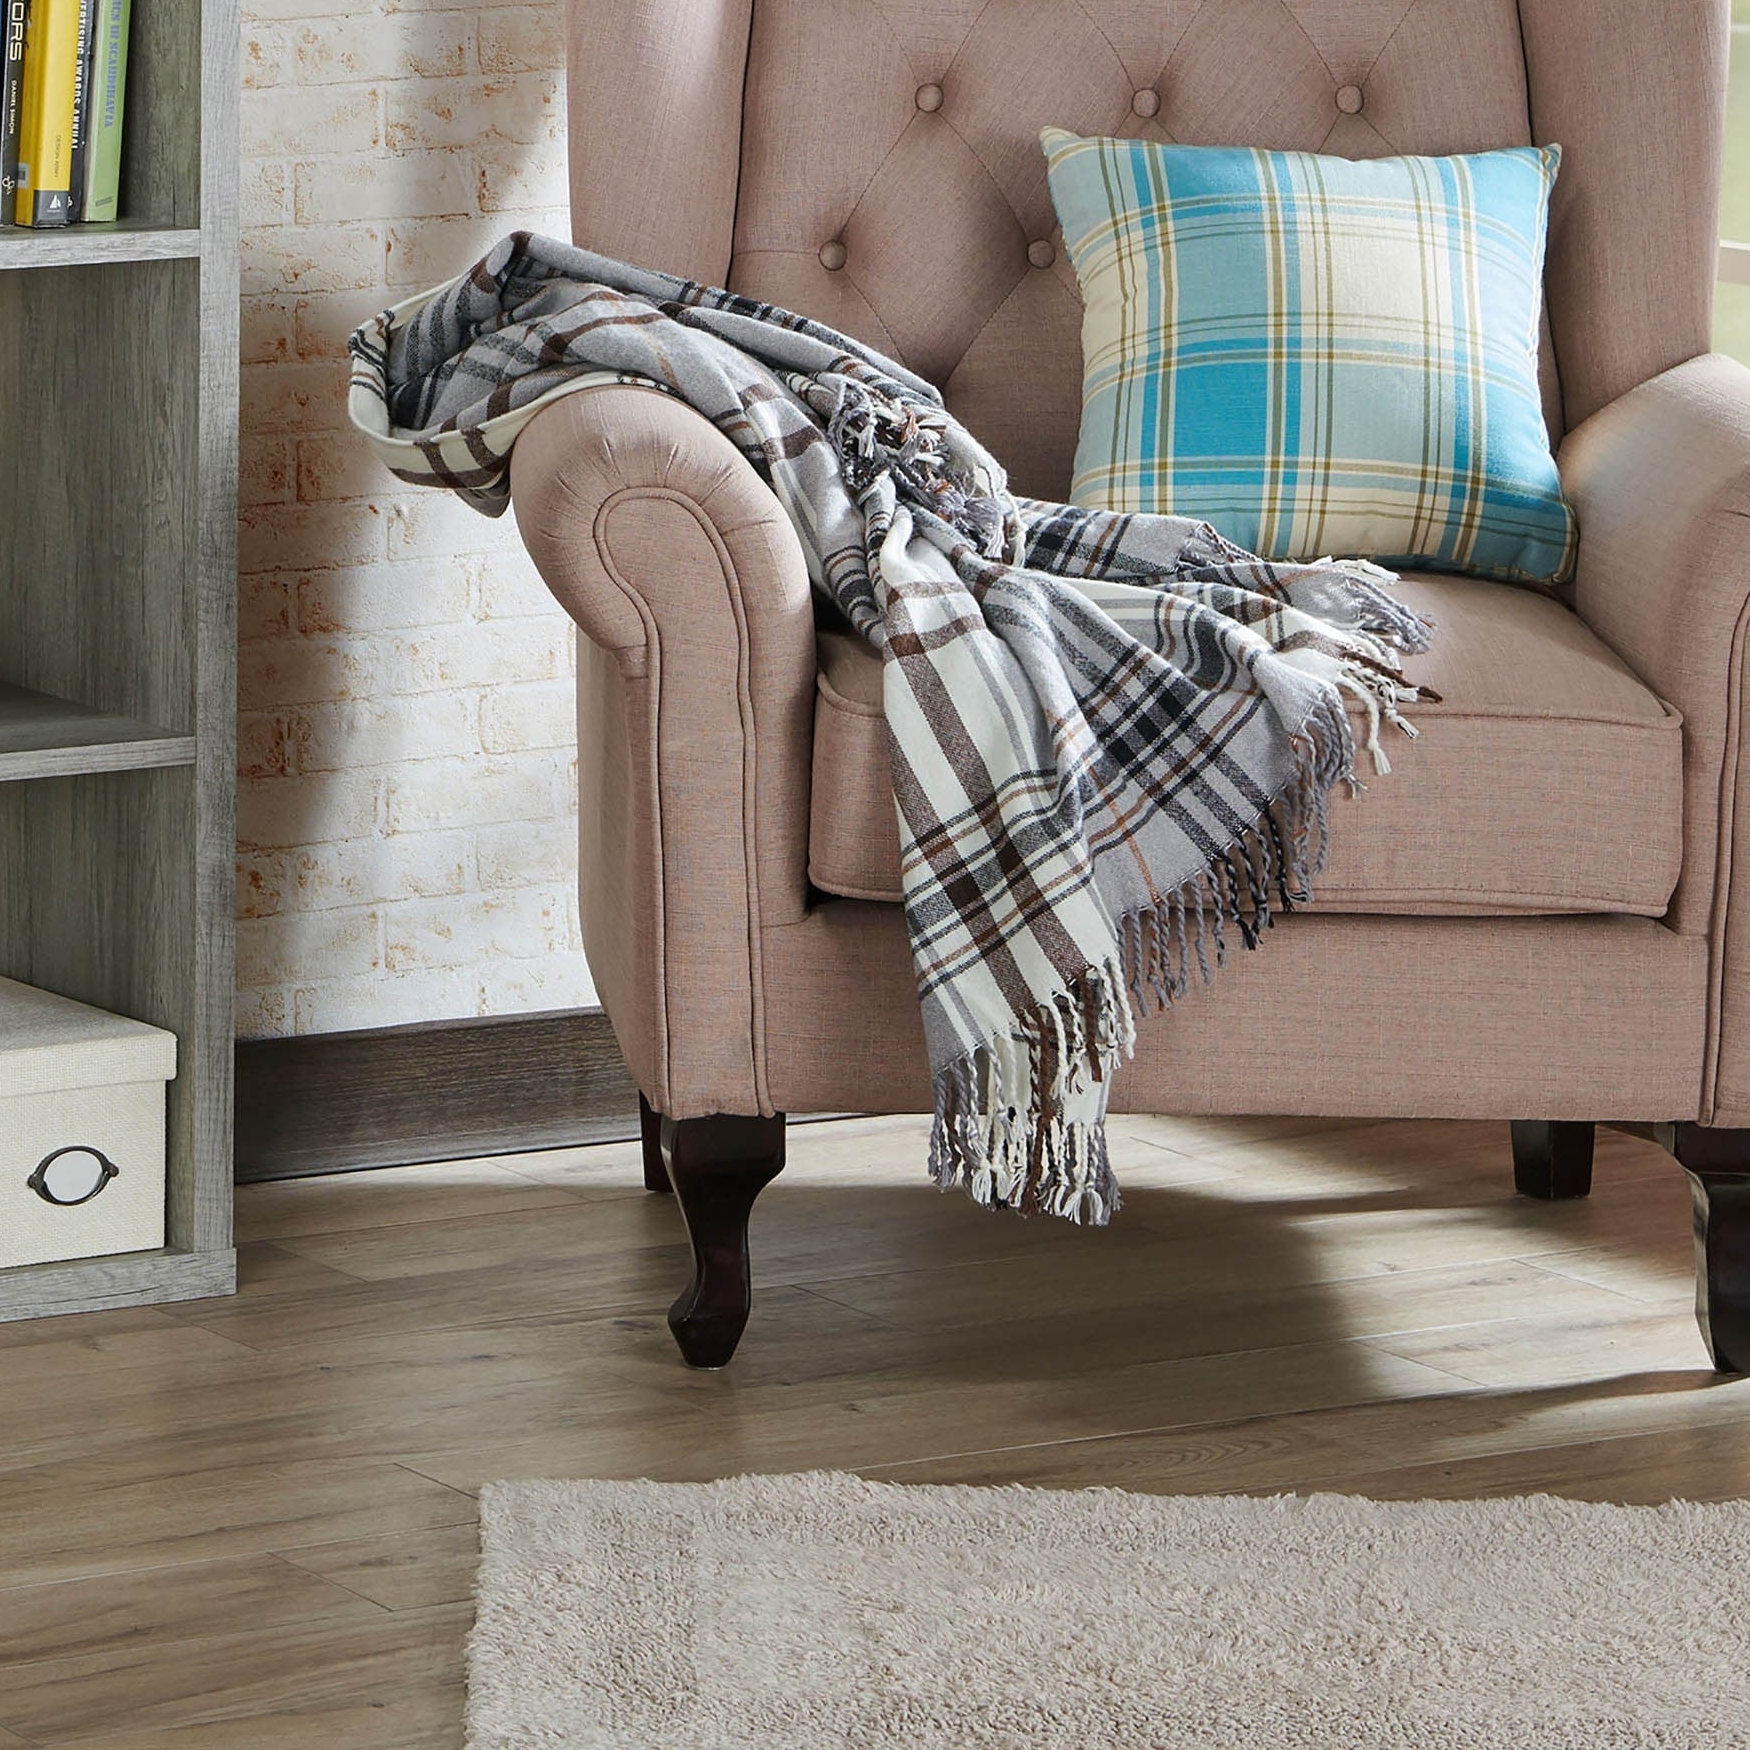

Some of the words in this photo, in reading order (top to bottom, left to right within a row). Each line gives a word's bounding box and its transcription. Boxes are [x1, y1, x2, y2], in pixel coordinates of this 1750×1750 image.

[9, 80, 17, 107] DANIEL
[73, 59, 83, 105] AWARDS
[104, 41, 119, 129] SCANDINAVIA
